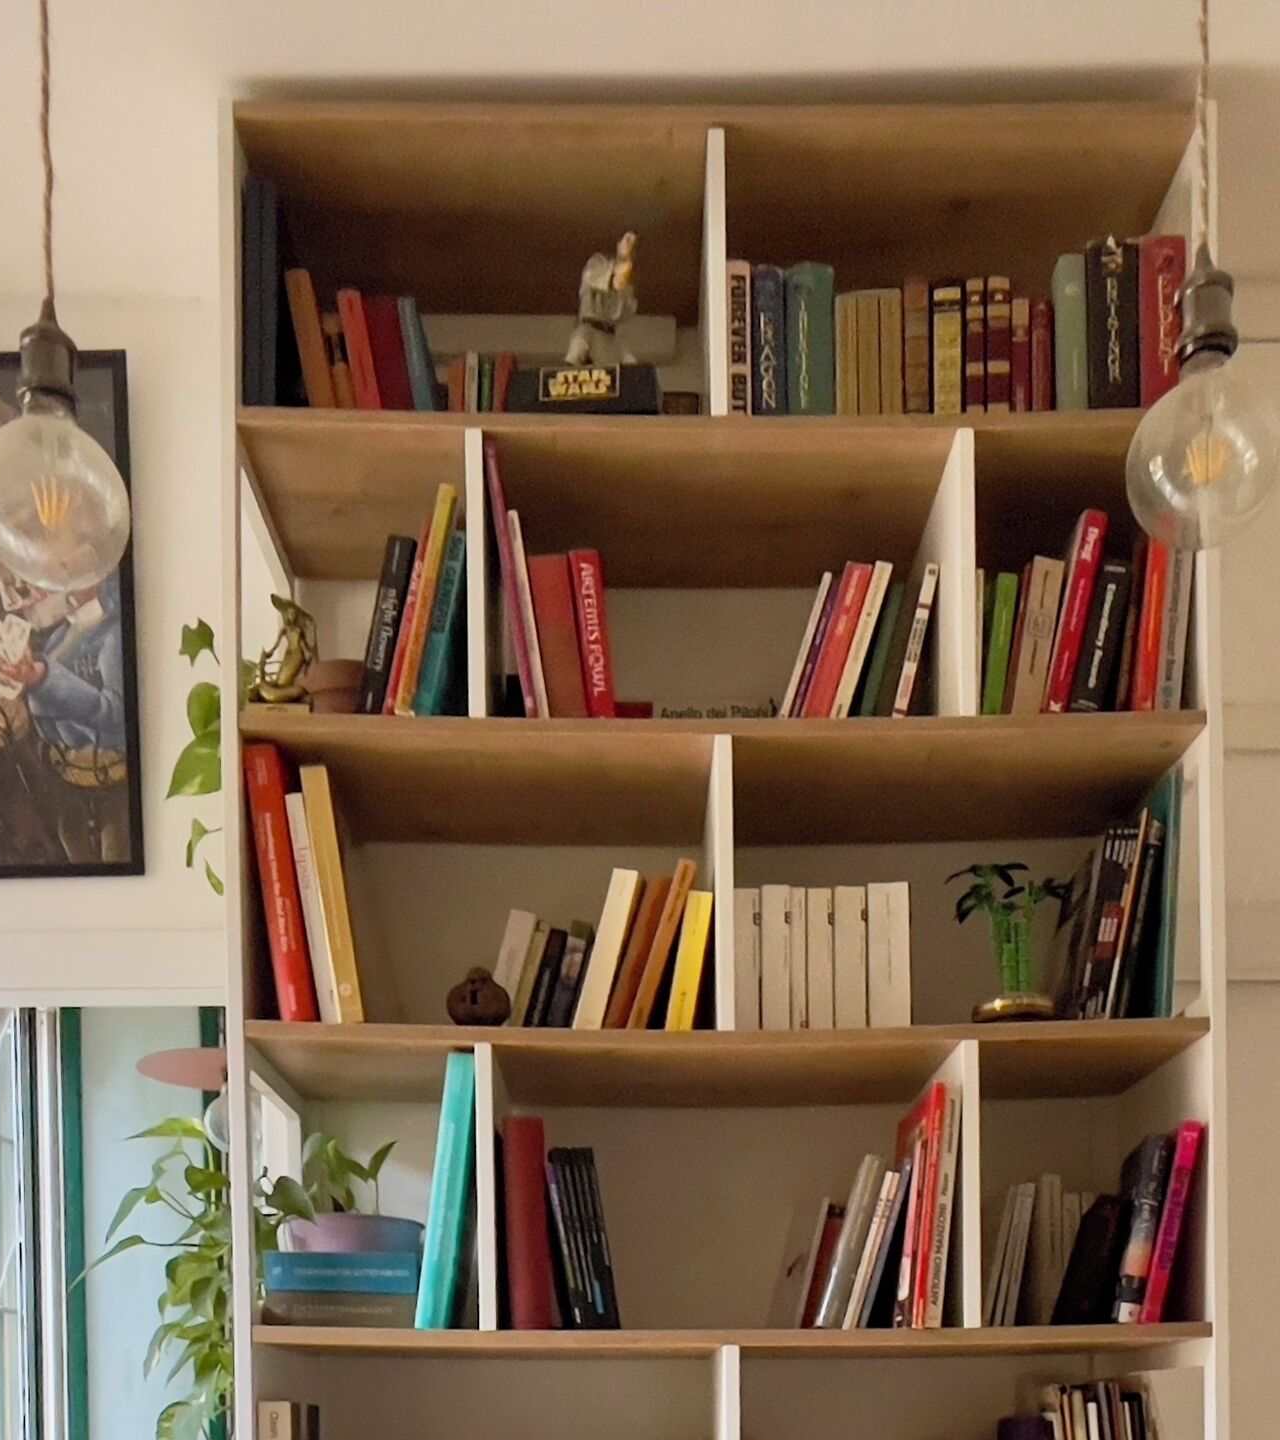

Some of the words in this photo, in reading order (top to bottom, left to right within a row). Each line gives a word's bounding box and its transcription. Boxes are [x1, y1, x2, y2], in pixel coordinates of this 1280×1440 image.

[730, 274, 747, 364] FOREVER
[1106, 276, 1123, 384] BRISINGR
[1157, 274, 1174, 376] ELDEST
[549, 368, 612, 385] STAR
[549, 380, 609, 397] WARS
[759, 312, 776, 409] ERAGON
[578, 562, 600, 641] ARTEMIS
[588, 641, 605, 697] FOWL
[934, 1202, 948, 1254] MANZONI
[929, 1256, 943, 1308] ANTONIO
